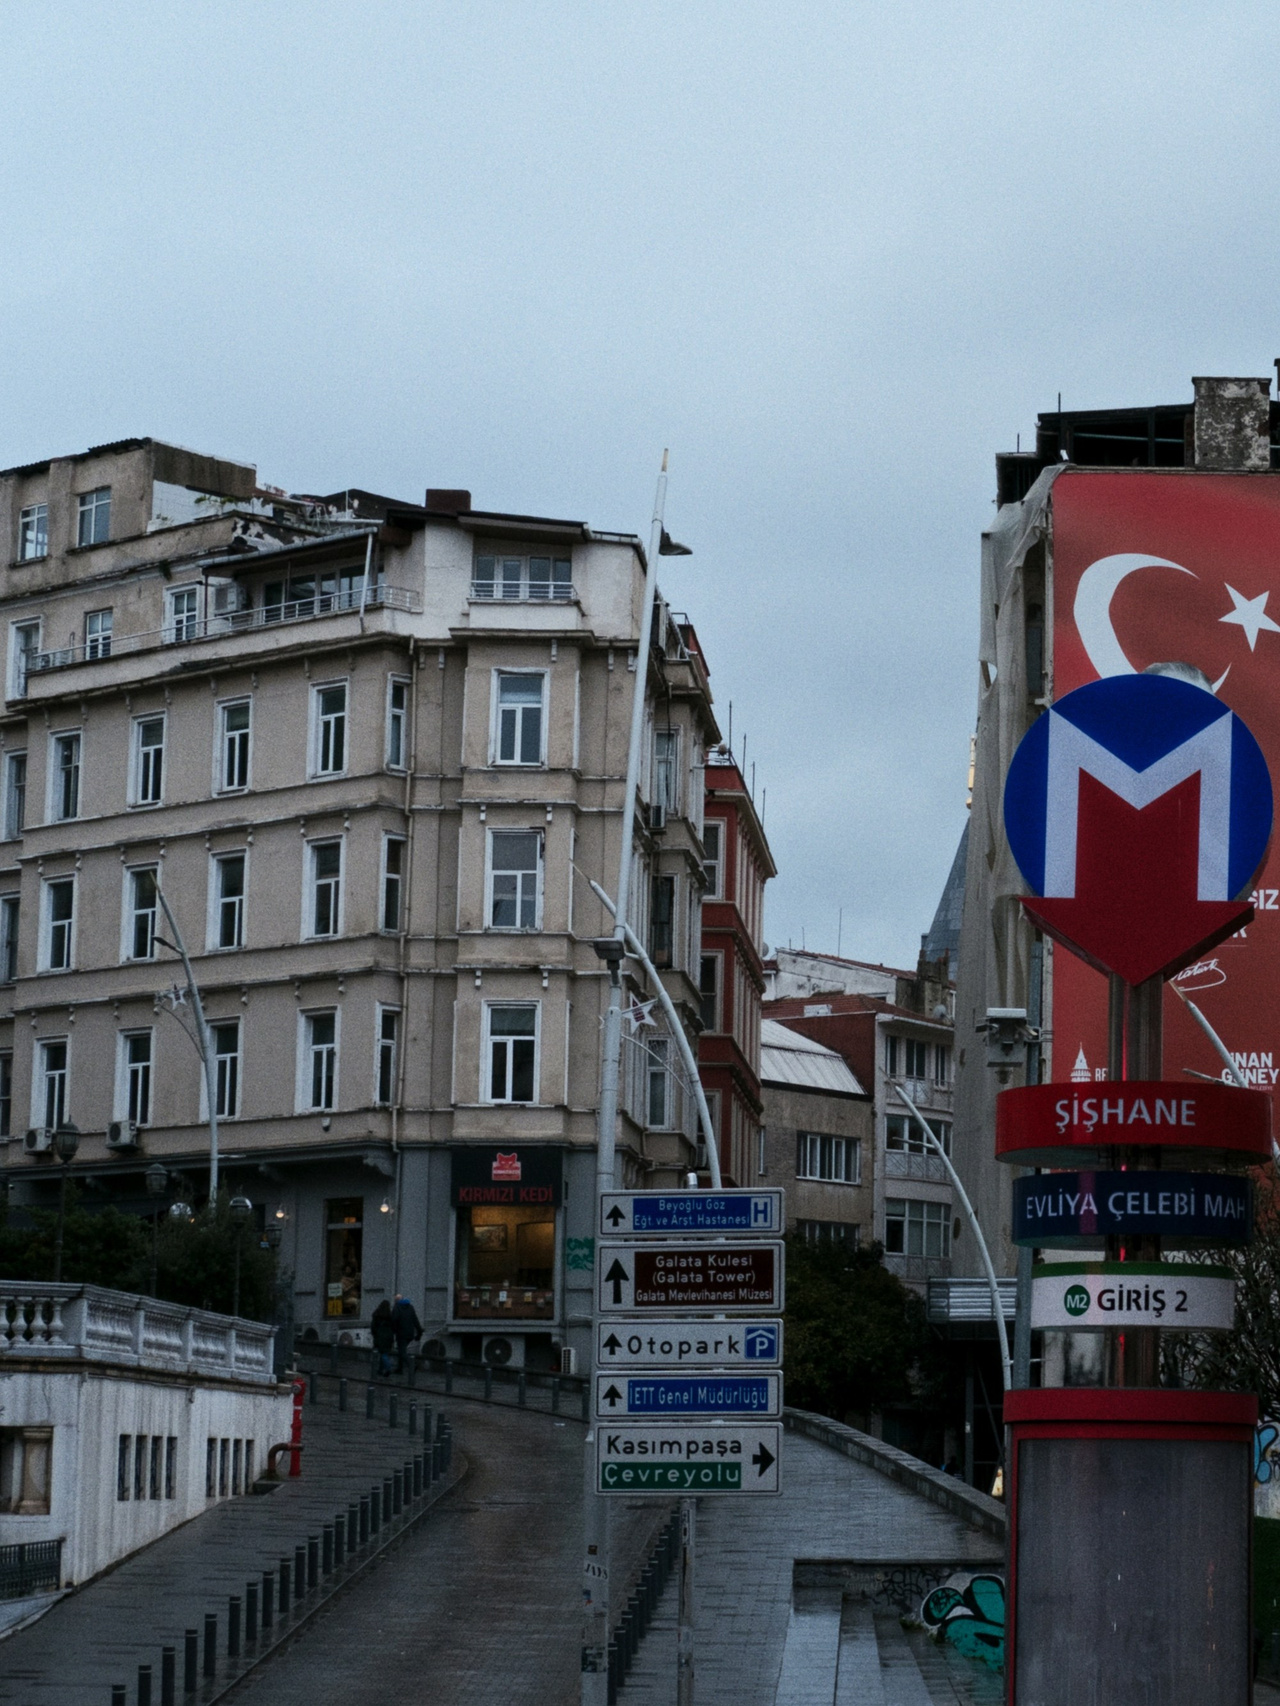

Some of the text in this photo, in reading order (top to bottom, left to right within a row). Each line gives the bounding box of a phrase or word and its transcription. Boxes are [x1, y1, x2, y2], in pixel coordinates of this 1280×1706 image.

[1055, 1093, 1197, 1134] ŞİŞHANE
[458, 1184, 553, 1203] KIRMIZI KEDİ
[658, 1199, 726, 1213] Beyoğlu Göz
[1026, 1188, 1246, 1222] EVLİYA ÇELEBİ MAH
[634, 1214, 750, 1229] Eğt. ve Arşt. Hastanesi
[655, 1254, 753, 1268] Galata Kulesi
[652, 1270, 756, 1286] (Galata Tower)
[636, 1288, 772, 1302] Galata Mevlevihanesi Müzesi
[1066, 1284, 1187, 1317] M2 GİRİŞ 2
[628, 1335, 740, 1360] Otopark
[755, 1337, 769, 1357] P
[629, 1382, 767, 1408] İETT Genel Müdürlüğü
[607, 1435, 742, 1459] Kasımpaşa
[604, 1464, 739, 1487] Çevreyolu
